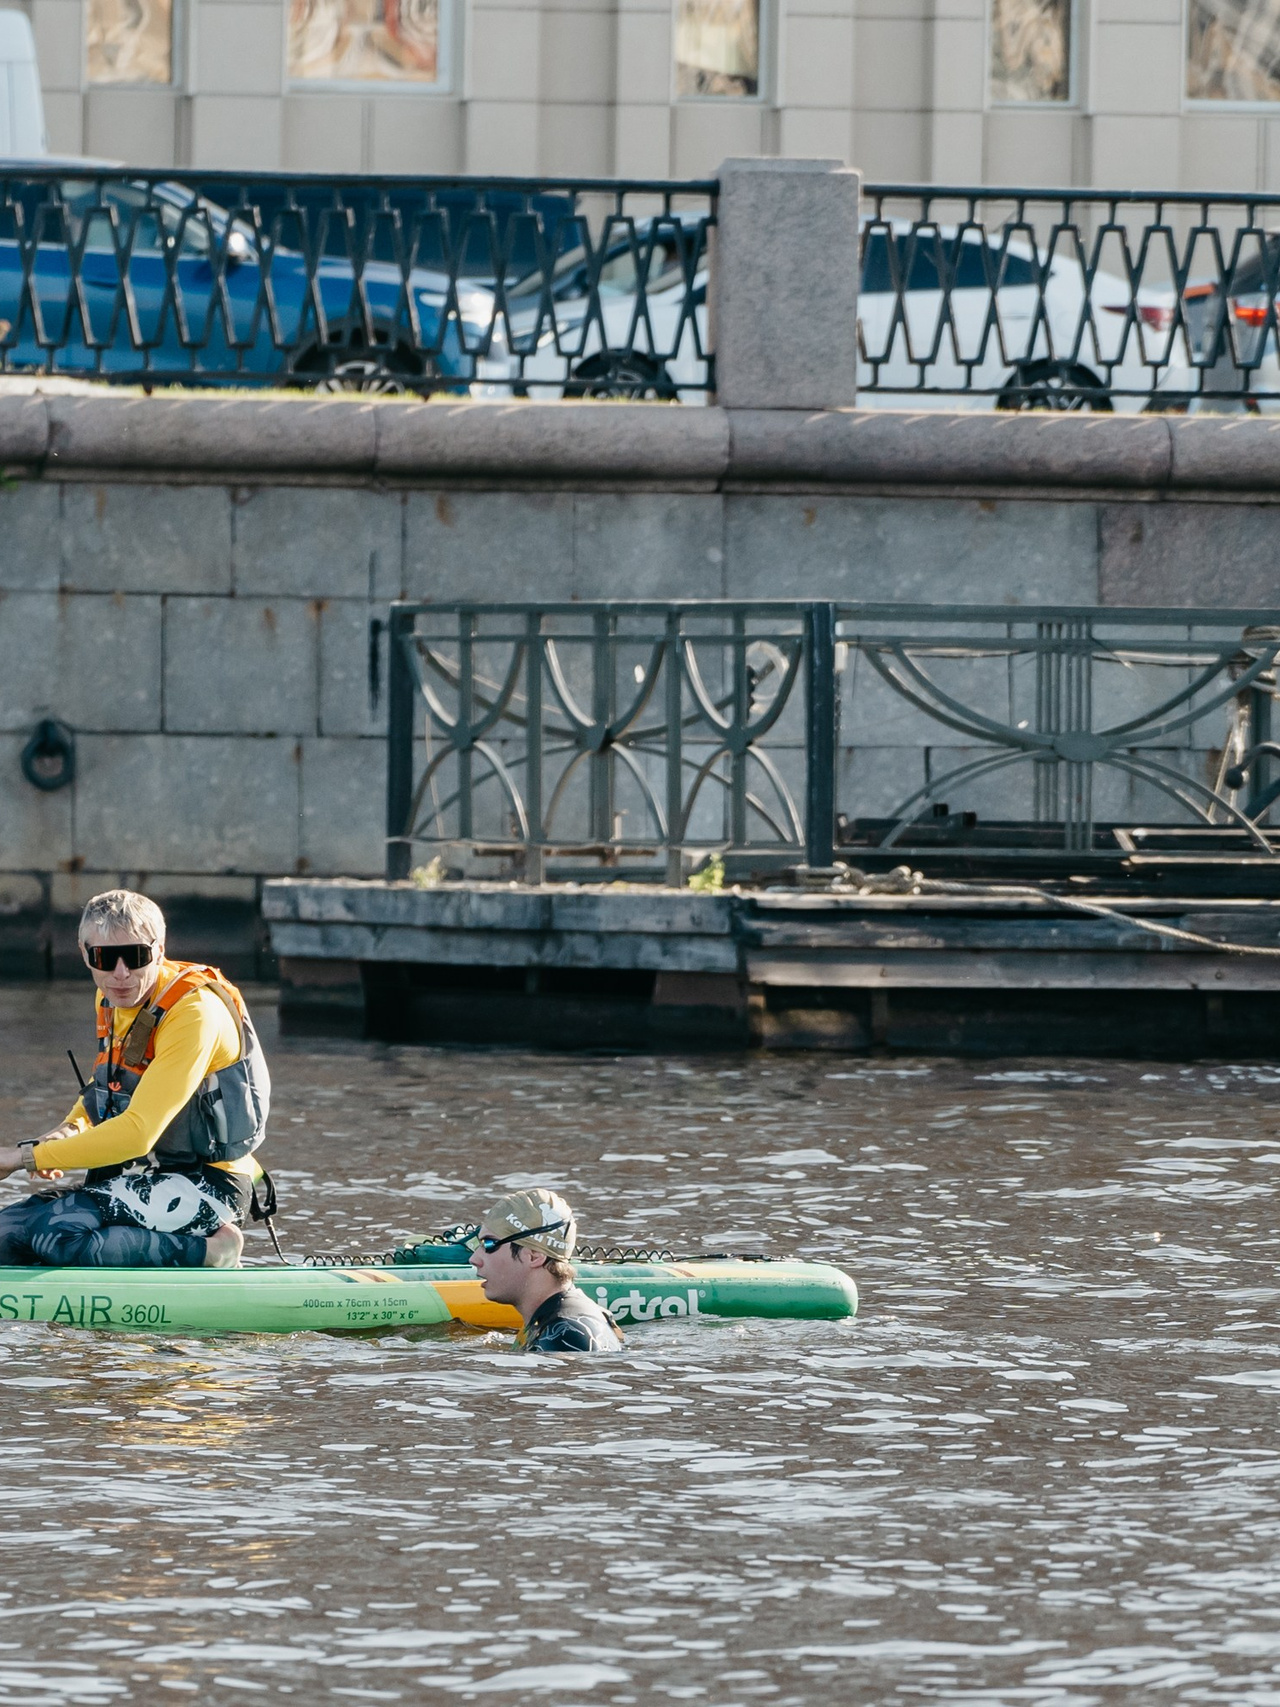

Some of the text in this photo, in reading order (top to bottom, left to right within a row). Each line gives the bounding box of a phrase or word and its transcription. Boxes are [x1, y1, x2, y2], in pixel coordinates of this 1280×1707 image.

[52, 1295, 114, 1324] AIR
[121, 1304, 172, 1324] 360L
[303, 1299, 334, 1308] 400cm
[337, 1300, 343, 1308] x
[345, 1298, 371, 1308] 76cm
[382, 1298, 408, 1307] 15cm
[596, 1286, 699, 1321] istral
